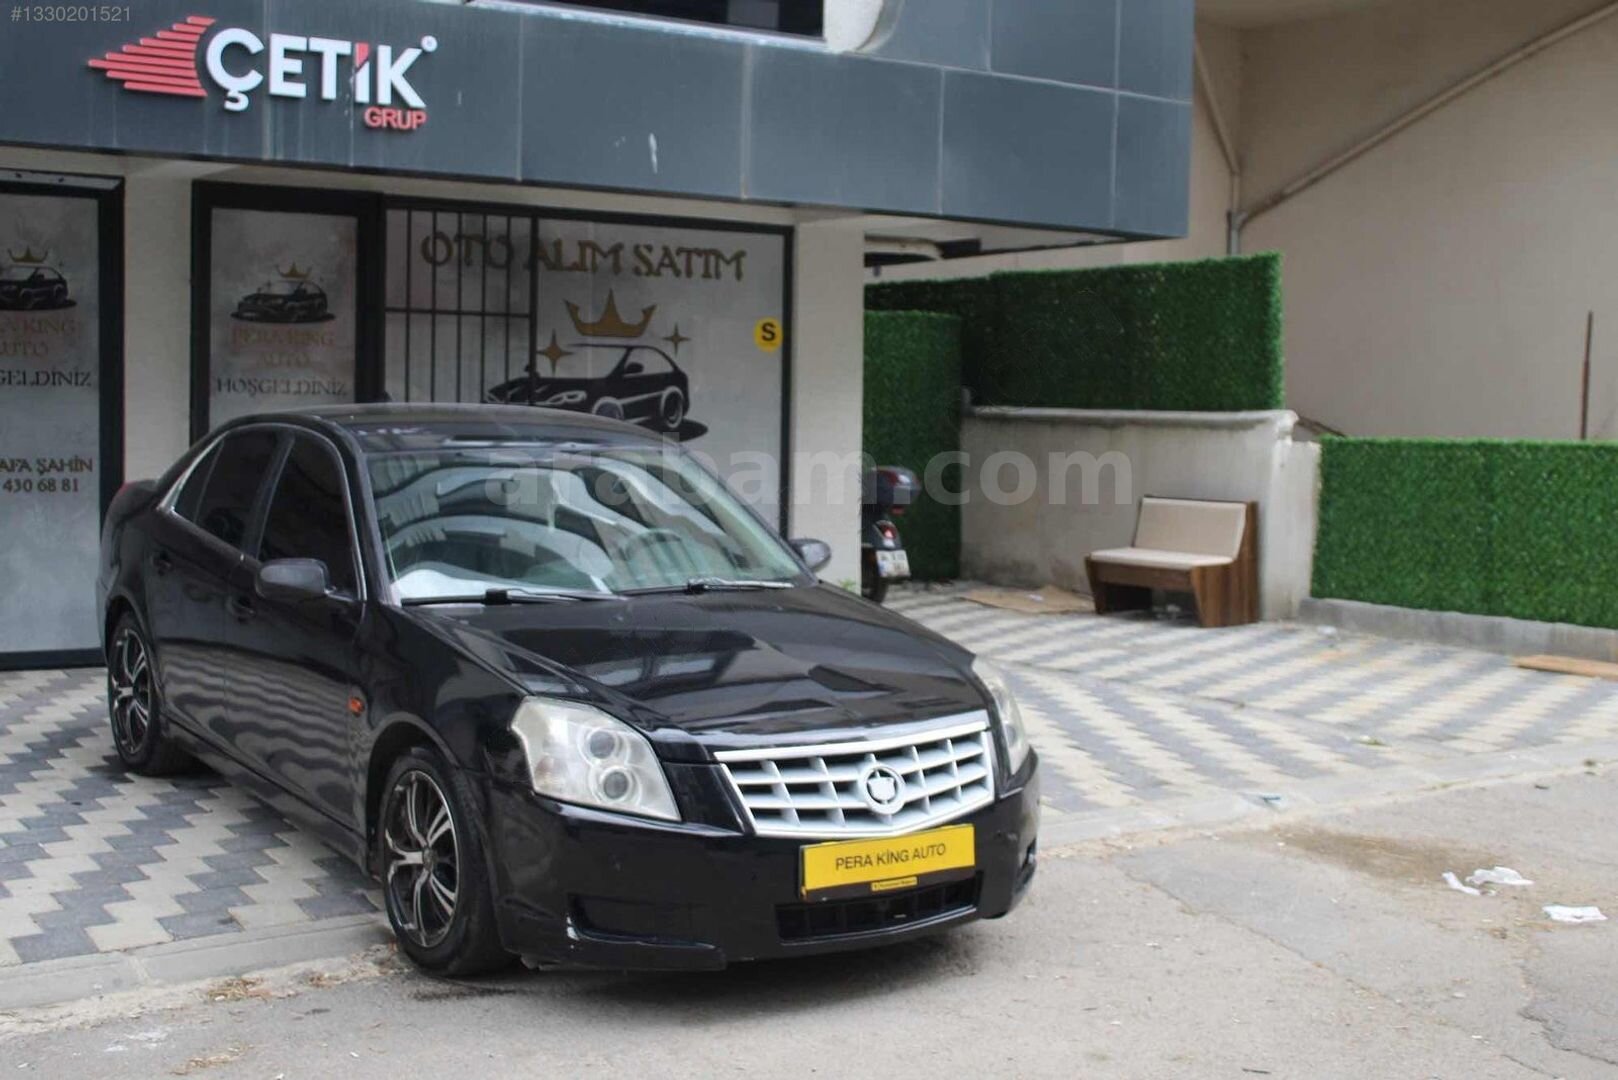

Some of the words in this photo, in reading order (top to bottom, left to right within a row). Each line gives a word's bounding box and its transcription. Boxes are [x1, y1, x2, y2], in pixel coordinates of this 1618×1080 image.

[364, 106, 427, 130] GRUP
[420, 231, 514, 270] OTO
[632, 243, 747, 282] SATIM
[761, 321, 777, 343] S
[0, 340, 49, 358] UTO
[36, 454, 93, 476] ŞAHİN
[3, 478, 33, 493] 430
[37, 478, 57, 493] 68
[62, 478, 79, 493] 81
[835, 855, 873, 870] PERA
[913, 843, 947, 860] AUTO
